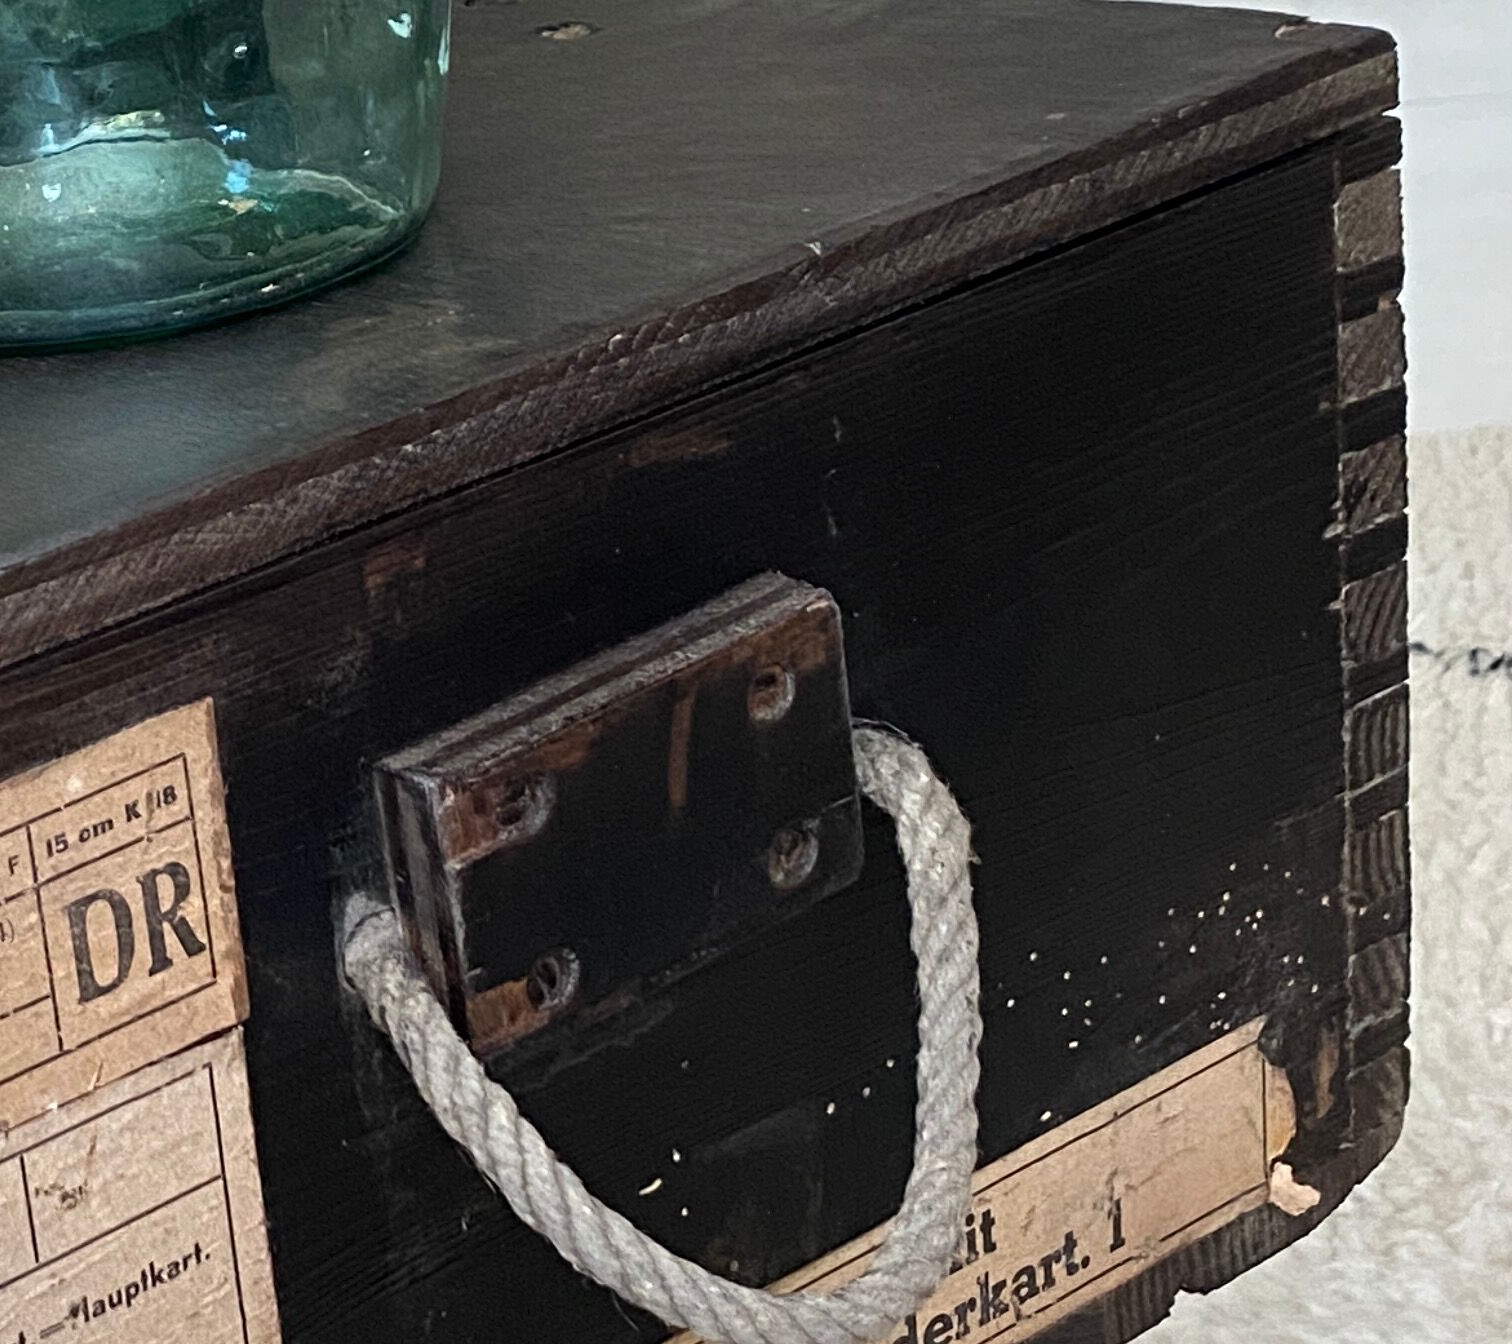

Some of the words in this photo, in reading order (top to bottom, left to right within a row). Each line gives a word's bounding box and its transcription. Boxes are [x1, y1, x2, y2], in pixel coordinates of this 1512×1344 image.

[45, 832, 69, 857] 15
[78, 818, 115, 844] cm
[63, 860, 207, 1005] DR
[949, 1208, 998, 1276] it
